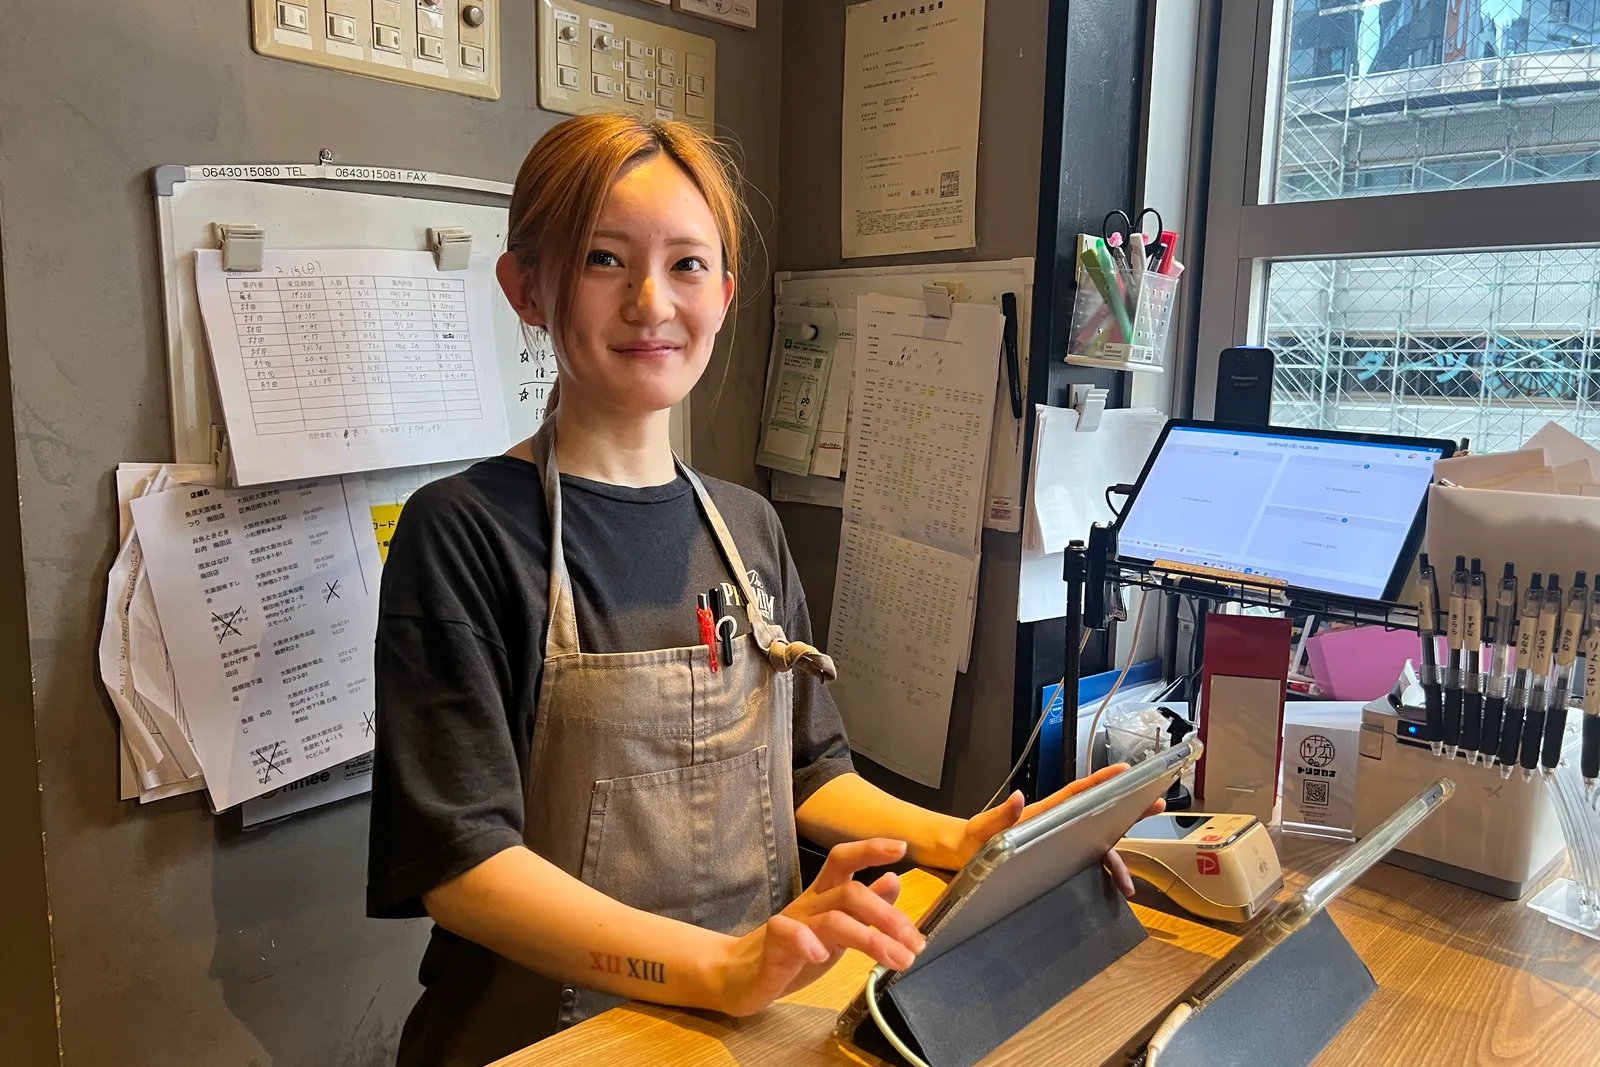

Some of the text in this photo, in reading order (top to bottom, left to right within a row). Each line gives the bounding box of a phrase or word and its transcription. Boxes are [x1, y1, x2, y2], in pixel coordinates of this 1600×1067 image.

[202, 166, 306, 178] 0643015080 TEL
[335, 168, 428, 182] 0643015081 FAX
[535, 387, 544, 399] 11
[190, 488, 210, 499] 店舗名
[237, 489, 280, 505] 大阪府大阪市北
[187, 519, 200, 527] つり
[206, 512, 226, 523] 梅田店
[192, 514, 287, 544] お魚ときどき 大阪府大阪市北区
[194, 545, 208, 554] お肉
[213, 538, 232, 549] 梅田店
[198, 556, 229, 570] 酒友はなび
[249, 539, 293, 556] 大阪府大阪市北区
[200, 568, 219, 580] 梅田店
[228, 580, 240, 588] すし
[255, 563, 299, 580] 大阪府大阪市北区
[261, 585, 305, 603] 大阪市北区角田町
[221, 616, 248, 629] ホイティ
[273, 629, 316, 647] 大阪府大阪市北区
[225, 669, 239, 678] 田店
[260, 709, 272, 718] めの
[288, 680, 330, 700] 大阪府大阪市北区
[301, 724, 344, 744] 大阪府大阪市北区
[256, 757, 293, 775] イト田茶屋
[626, 957, 666, 985] XIII
